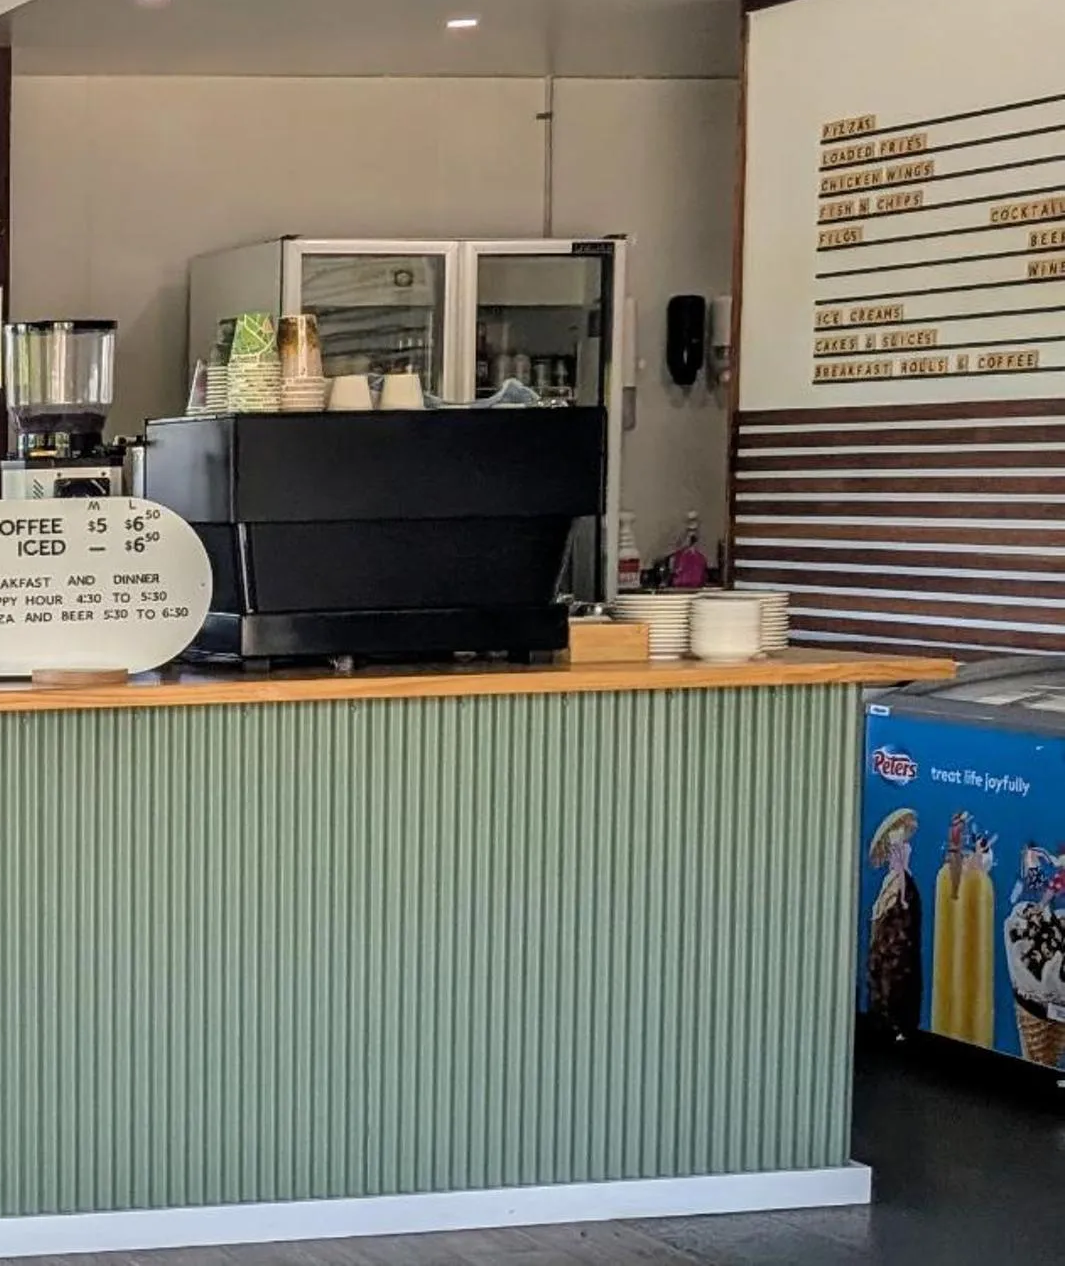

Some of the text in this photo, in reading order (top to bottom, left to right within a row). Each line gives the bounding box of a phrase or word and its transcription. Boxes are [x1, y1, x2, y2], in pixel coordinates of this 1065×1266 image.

[822, 118, 871, 138] PIZZAS
[822, 137, 923, 166] LOADED FRIES
[820, 164, 931, 192] CHICKEN WINGS
[819, 204, 852, 219] FISH
[876, 194, 920, 212] CHIPS
[817, 307, 901, 326] ICE CREAMS
[815, 338, 855, 352] CAKES
[882, 331, 932, 347] SLICES
[815, 363, 891, 378] BREAKFAST
[900, 359, 945, 374] ROLLS
[978, 353, 1034, 370] COFFEE
[88, 500, 136, 511] M L
[88, 517, 108, 533] $5
[17, 539, 67, 557] ICED
[67, 575, 96, 586] AND
[112, 573, 160, 585] DINNER
[25, 595, 63, 606] HOUR
[75, 593, 102, 604] 4:30
[112, 592, 131, 603] TO
[140, 590, 168, 602] 5:30
[24, 612, 53, 623] AND
[61, 610, 94, 621] BEER
[103, 609, 129, 620] 5:30
[136, 609, 156, 620] TO
[162, 607, 190, 618] 6:30
[873, 750, 917, 778] Peters
[931, 766, 1031, 797] treat life joyfully
